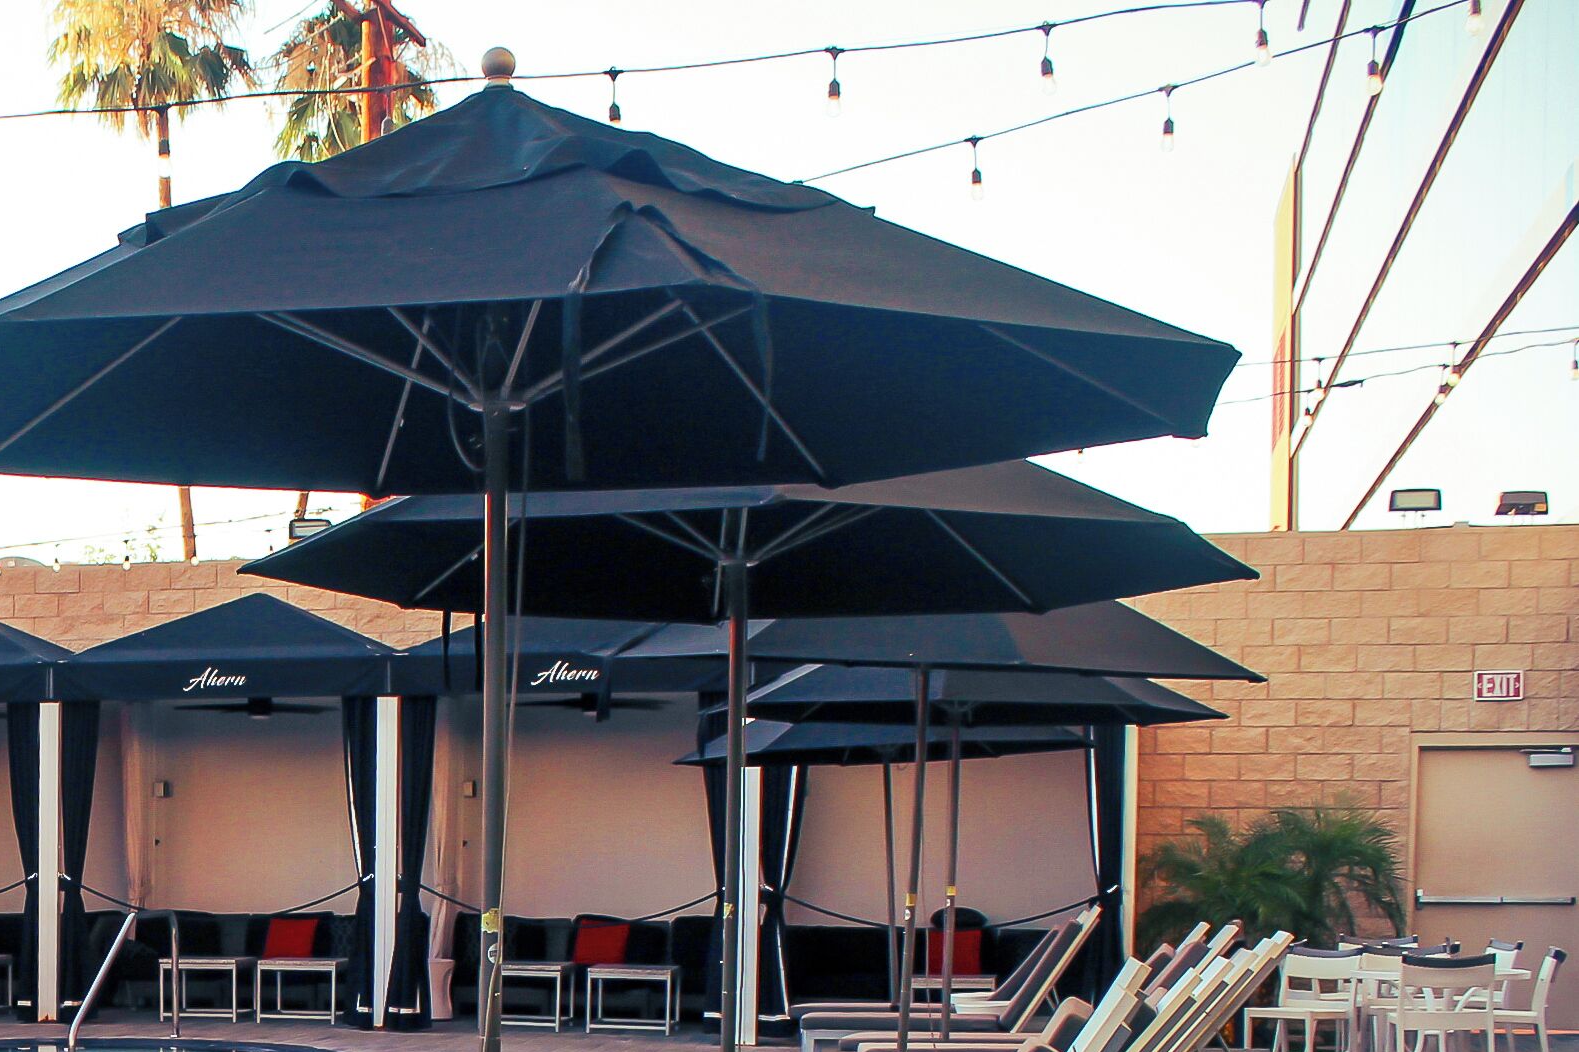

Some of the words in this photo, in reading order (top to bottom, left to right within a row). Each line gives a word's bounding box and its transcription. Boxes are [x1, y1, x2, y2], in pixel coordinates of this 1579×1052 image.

[182, 666, 247, 692] Ahern
[530, 660, 600, 686] Ahern
[1482, 674, 1517, 696] EXIT
